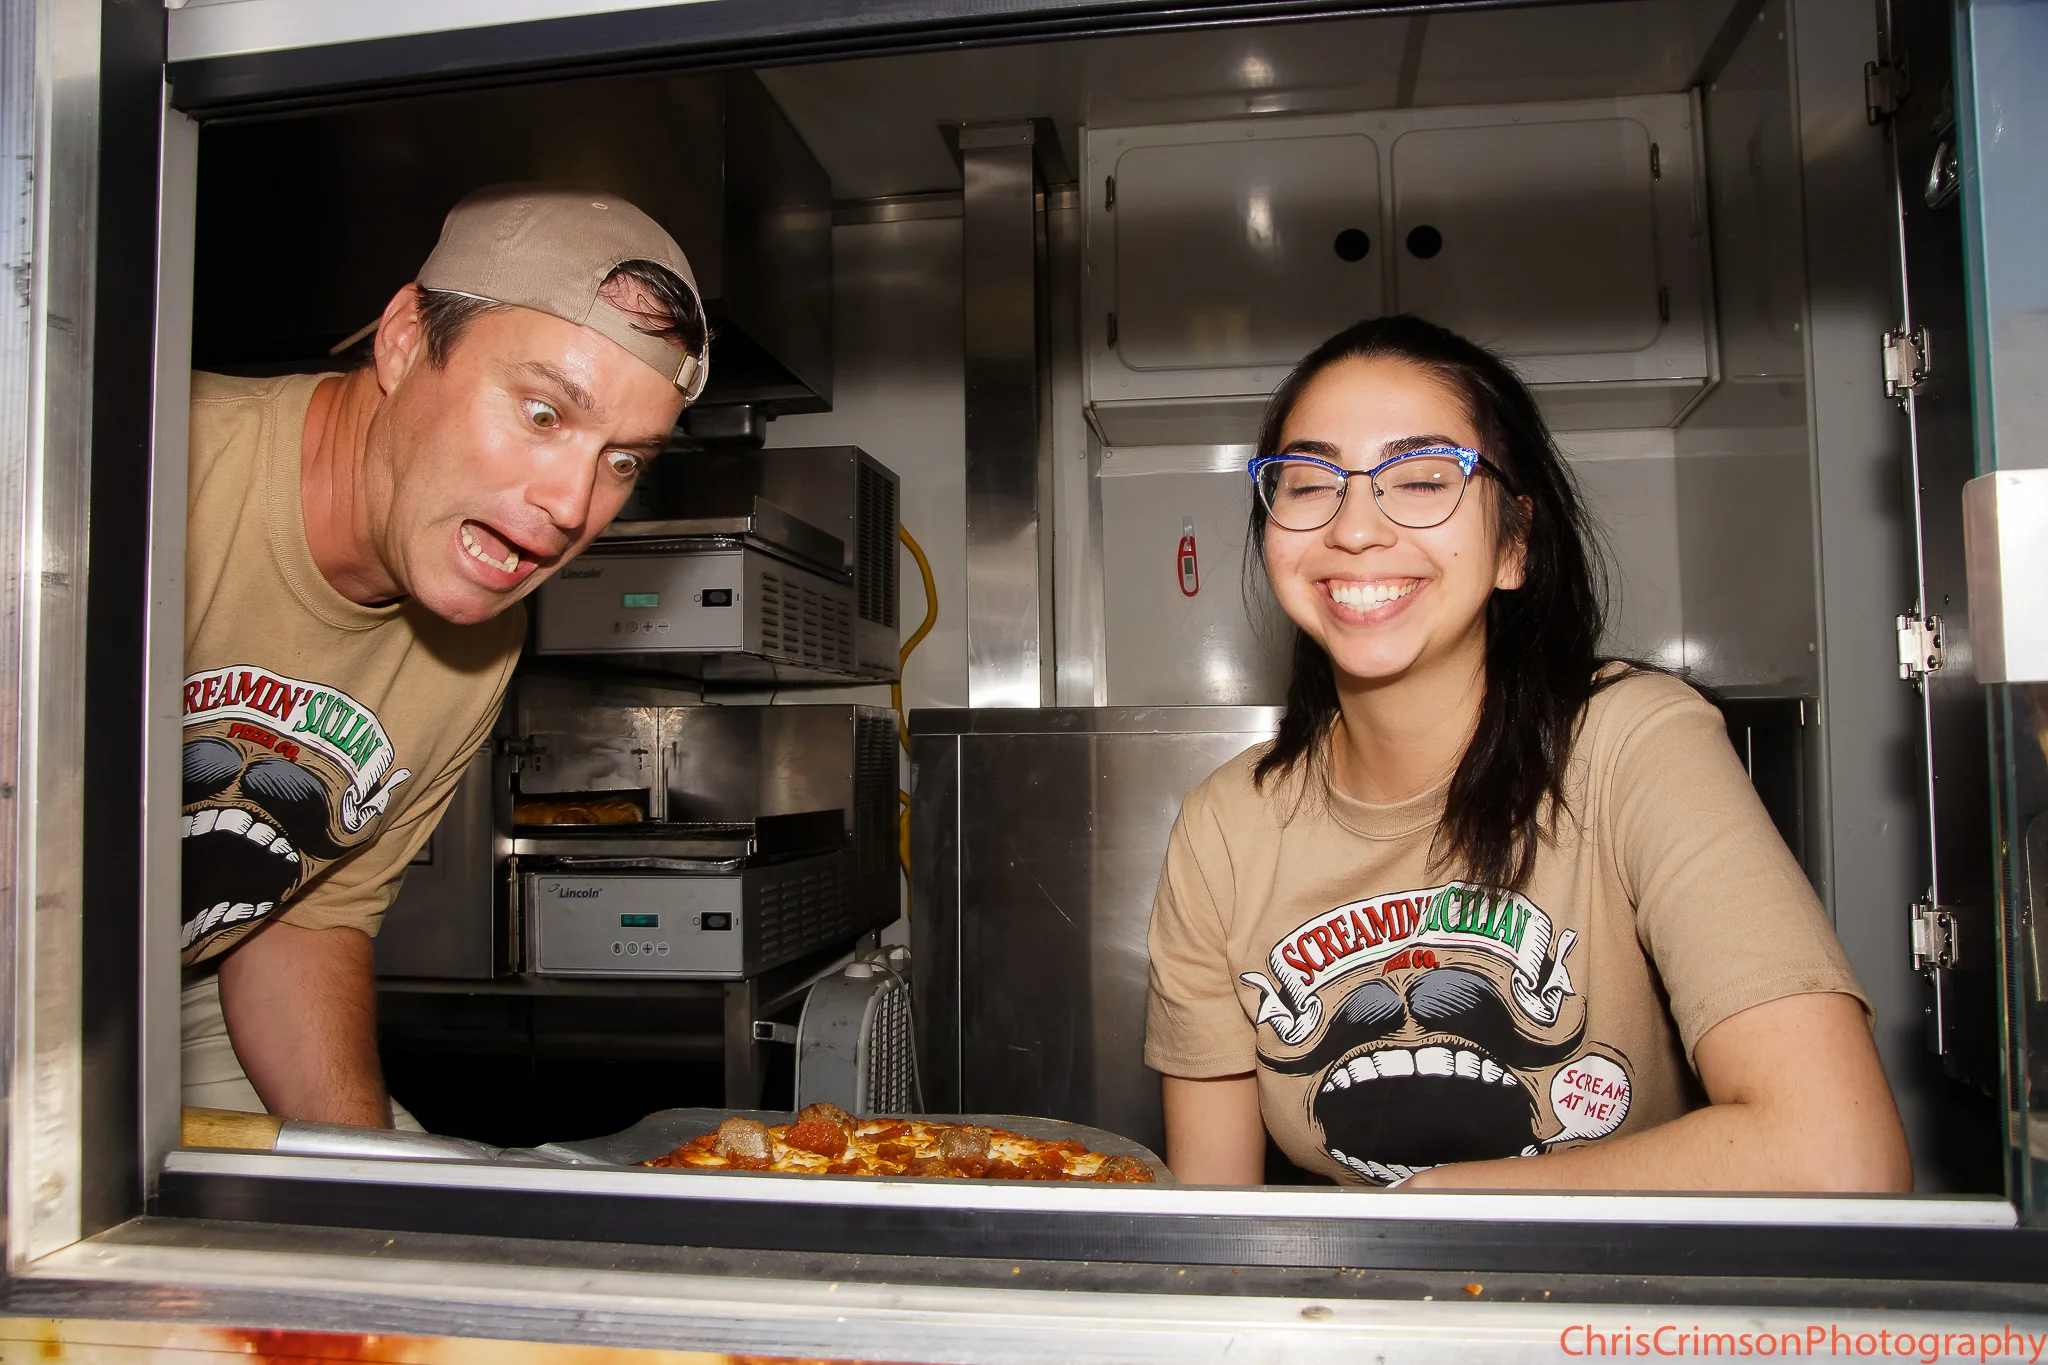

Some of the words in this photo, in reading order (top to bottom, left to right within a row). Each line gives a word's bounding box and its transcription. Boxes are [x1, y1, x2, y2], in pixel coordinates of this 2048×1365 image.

[227, 722, 279, 750] PIZZA
[292, 691, 384, 772] SICILIAN
[559, 887, 600, 898] Lincoln
[1412, 949, 1441, 969] CO.
[1563, 1069, 1627, 1102] SCREAM
[1558, 1091, 1585, 1111] AT
[1583, 1099, 1617, 1122] ME!
